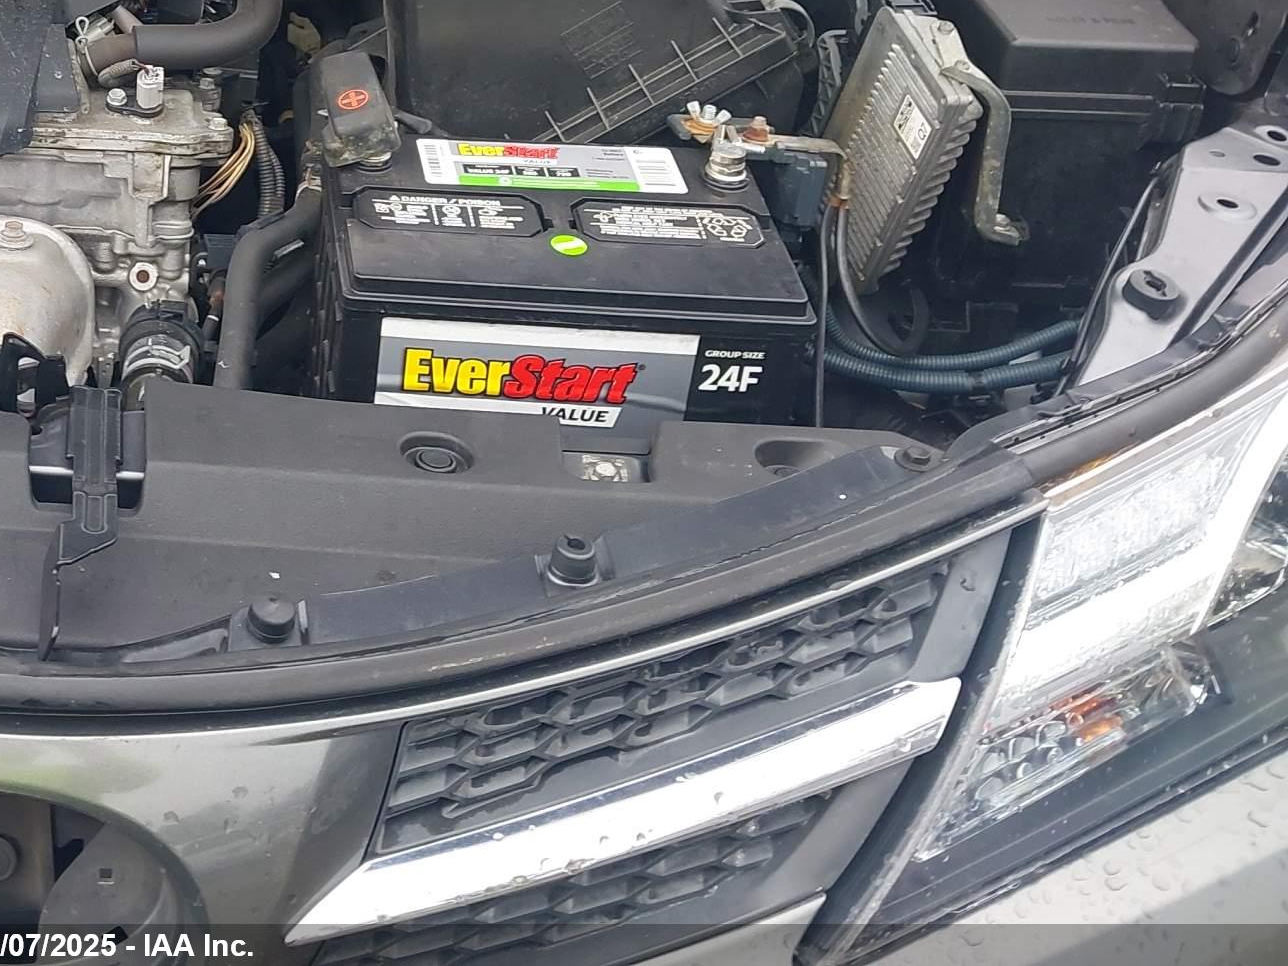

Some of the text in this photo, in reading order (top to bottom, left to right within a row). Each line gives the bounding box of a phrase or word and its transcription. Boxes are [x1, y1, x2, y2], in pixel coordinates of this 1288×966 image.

[457, 143, 560, 159] EverStart
[401, 195, 447, 204] DANGER
[458, 198, 501, 207] POISON
[705, 349, 766, 360] GROUP SIZE
[402, 347, 637, 404] EverStart
[698, 364, 763, 393] 24F
[542, 407, 609, 424] VALUE
